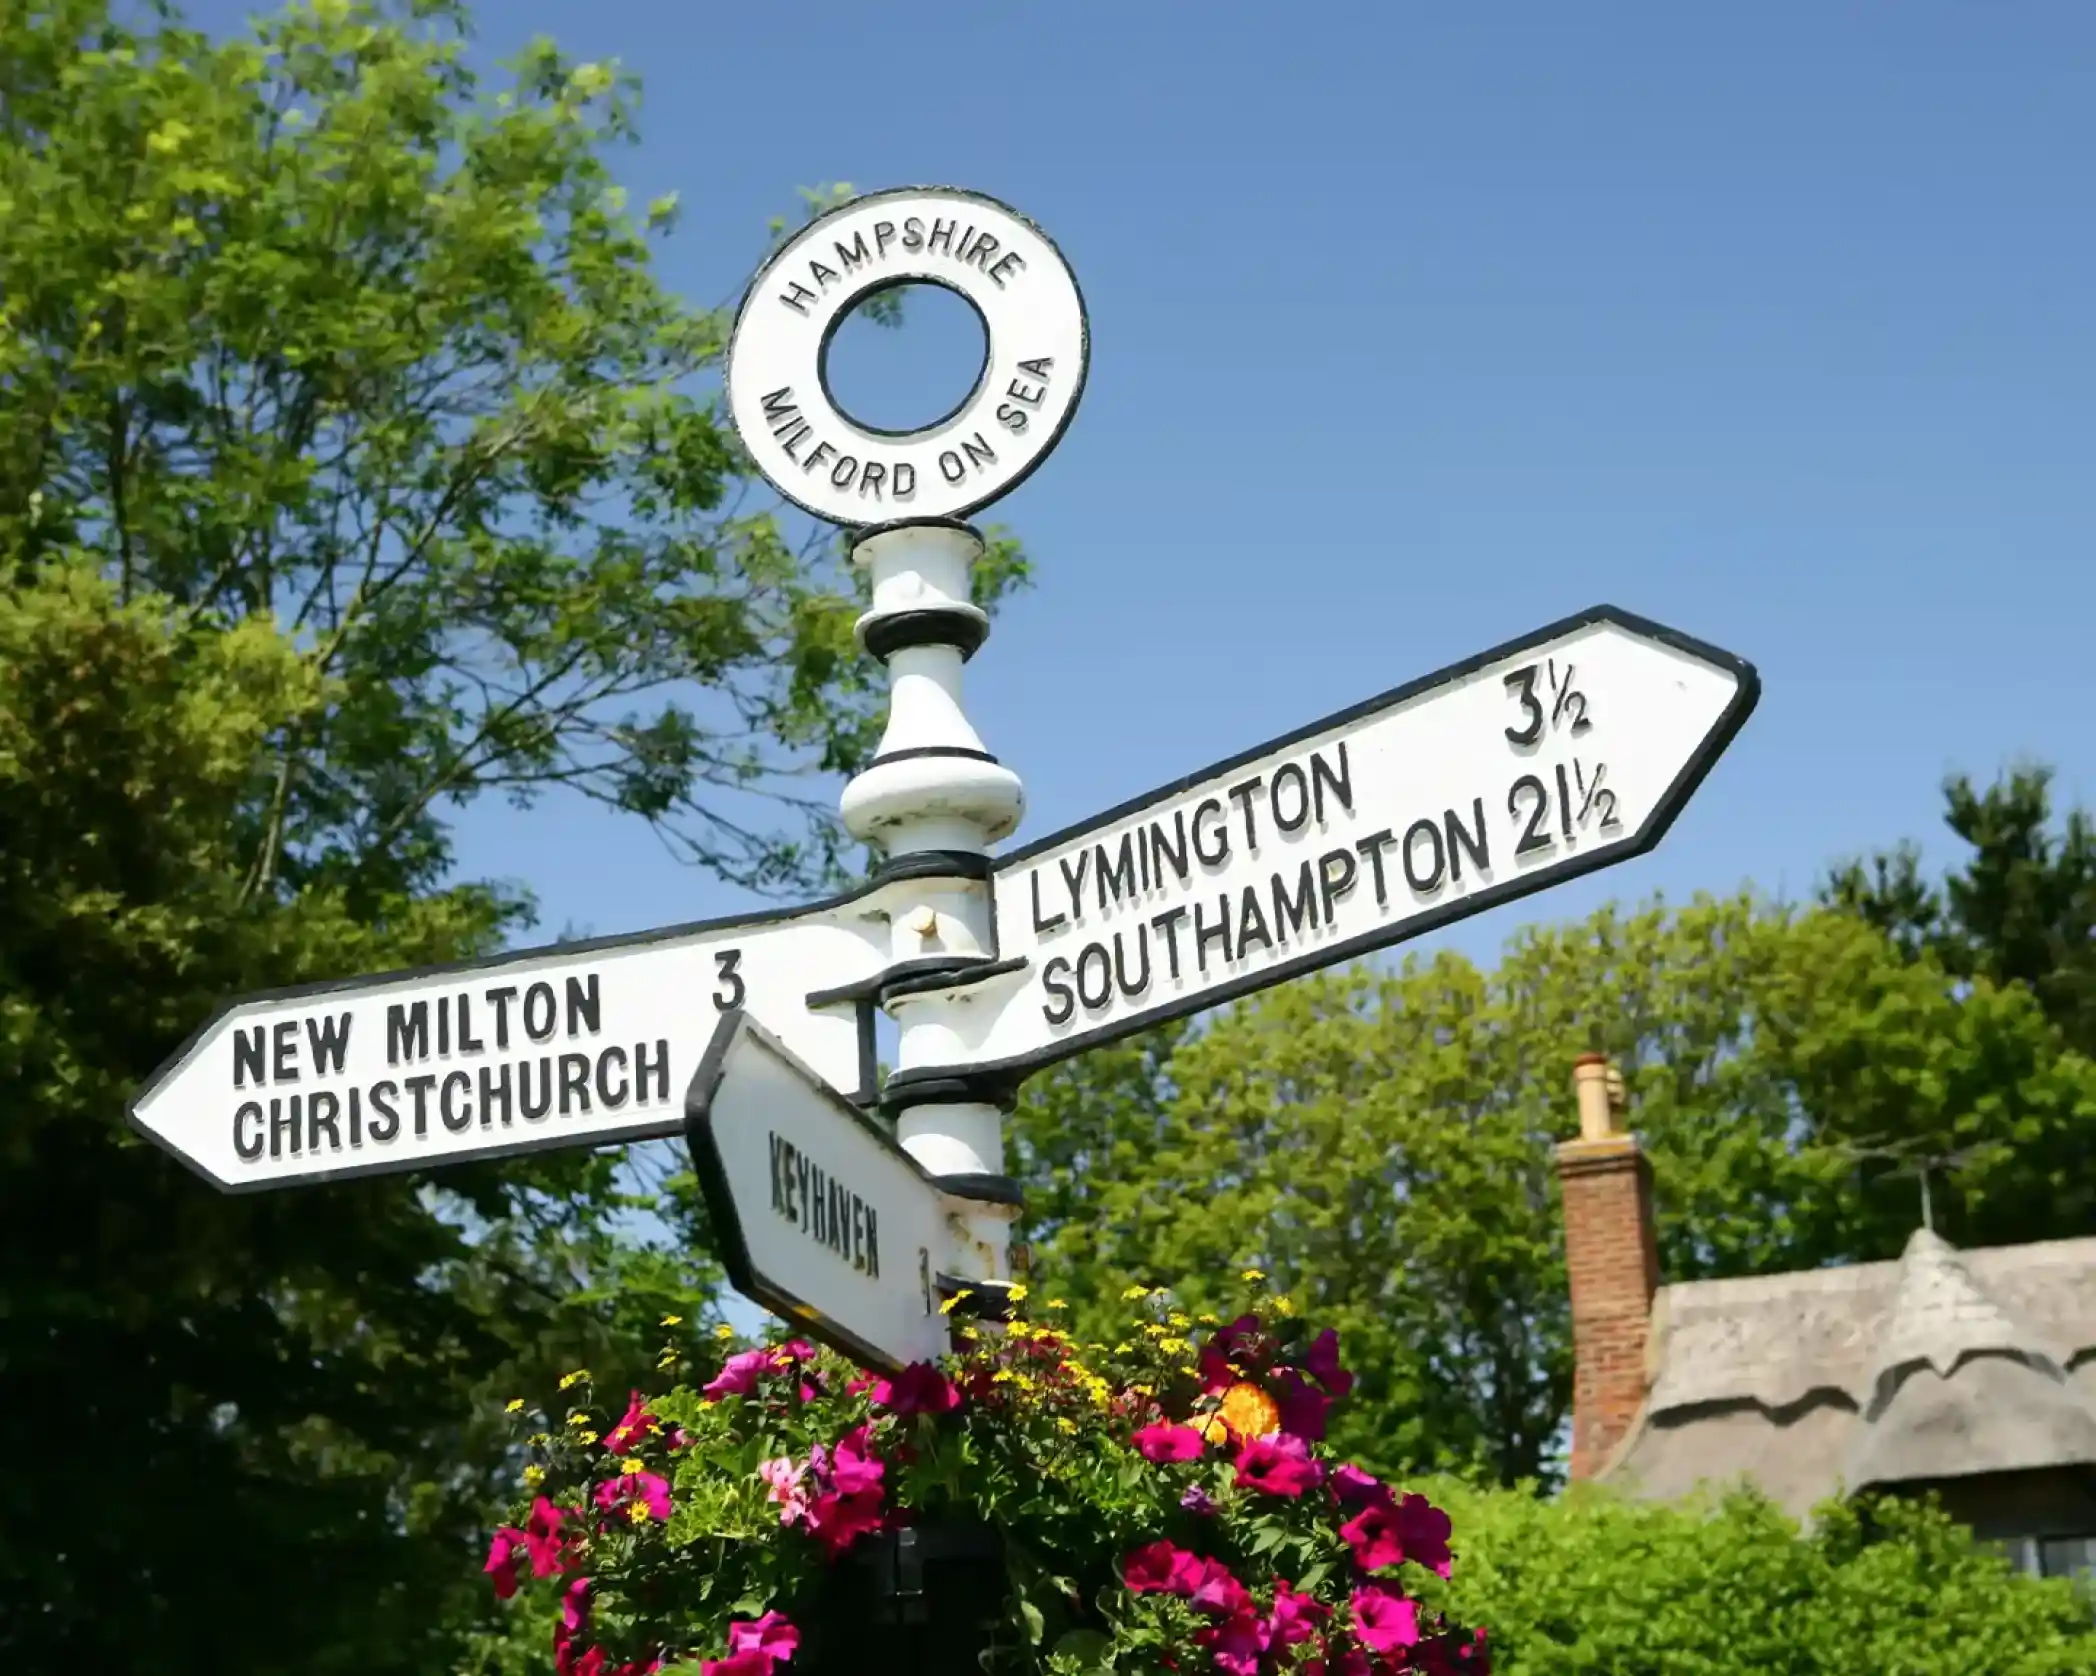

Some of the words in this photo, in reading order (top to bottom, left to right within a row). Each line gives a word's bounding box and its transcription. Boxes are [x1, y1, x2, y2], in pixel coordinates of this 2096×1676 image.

[779, 216, 1026, 313] HAMPSHIRE
[761, 386, 915, 497] MILFORD
[938, 431, 996, 484] ON
[996, 356, 1055, 431] SEA
[1030, 742, 1354, 935] LYMINGTON
[1041, 797, 1491, 1026] SOUTHAMPTON
[233, 1012, 352, 1088] NEW
[386, 974, 602, 1064] MILTON
[712, 949, 745, 1011] 3
[232, 1038, 670, 1159] CHRISTCHURCH
[769, 1130, 880, 1280] KEYHAVEN
